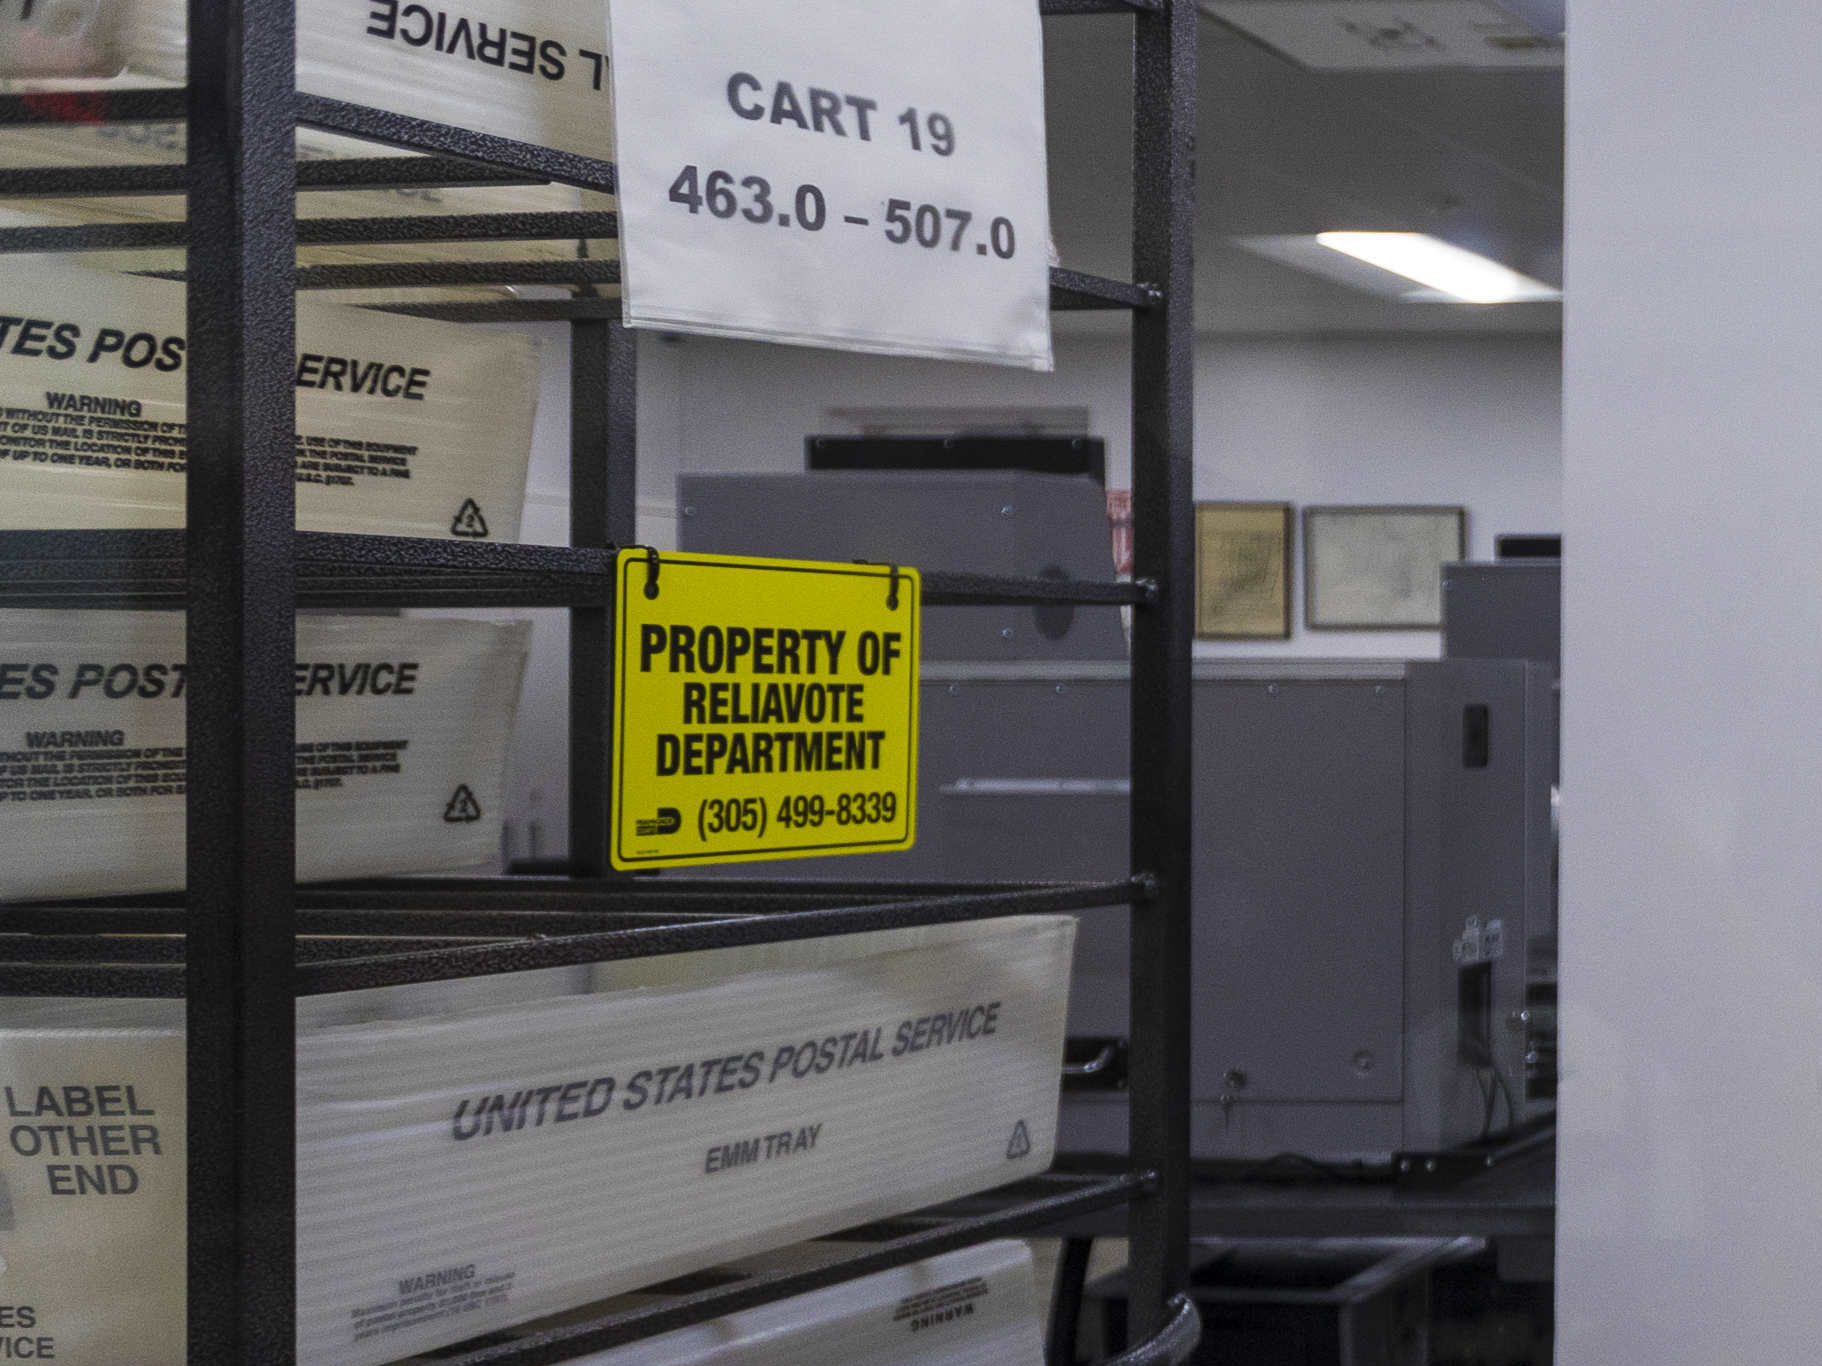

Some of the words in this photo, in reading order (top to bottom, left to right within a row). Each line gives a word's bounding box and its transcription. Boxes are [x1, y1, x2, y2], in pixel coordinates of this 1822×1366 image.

[366, 0, 566, 80] SERVICE
[726, 72, 878, 142] CART
[897, 107, 955, 157] 19
[668, 165, 827, 231] 463.0
[884, 198, 1016, 260] 507.0
[0, 316, 81, 359] TES
[88, 330, 184, 372] POS
[296, 353, 431, 400] ERVICE
[45, 391, 143, 417] WARNING
[640, 623, 846, 675] PROPERTY
[857, 631, 902, 676] OF
[68, 663, 187, 700] POST
[295, 662, 420, 697] ERVICE
[683, 682, 864, 724] RELIAVOTE
[25, 729, 125, 748] WARNING
[656, 730, 885, 776] DEPARTMENT
[697, 796, 768, 842] (305)
[776, 791, 897, 829] 499-8339
[452, 1075, 615, 1141] UNITED
[622, 1052, 764, 1111] STATES
[767, 1026, 886, 1084] POSTAL
[892, 1001, 1002, 1057] SERVICE
[4, 1085, 156, 1117] LABEL
[9, 1124, 162, 1157] OTHER
[705, 1136, 760, 1174] EMM
[763, 1124, 822, 1165] TRAY
[46, 1164, 139, 1195] END
[399, 1263, 476, 1295] WARNING
